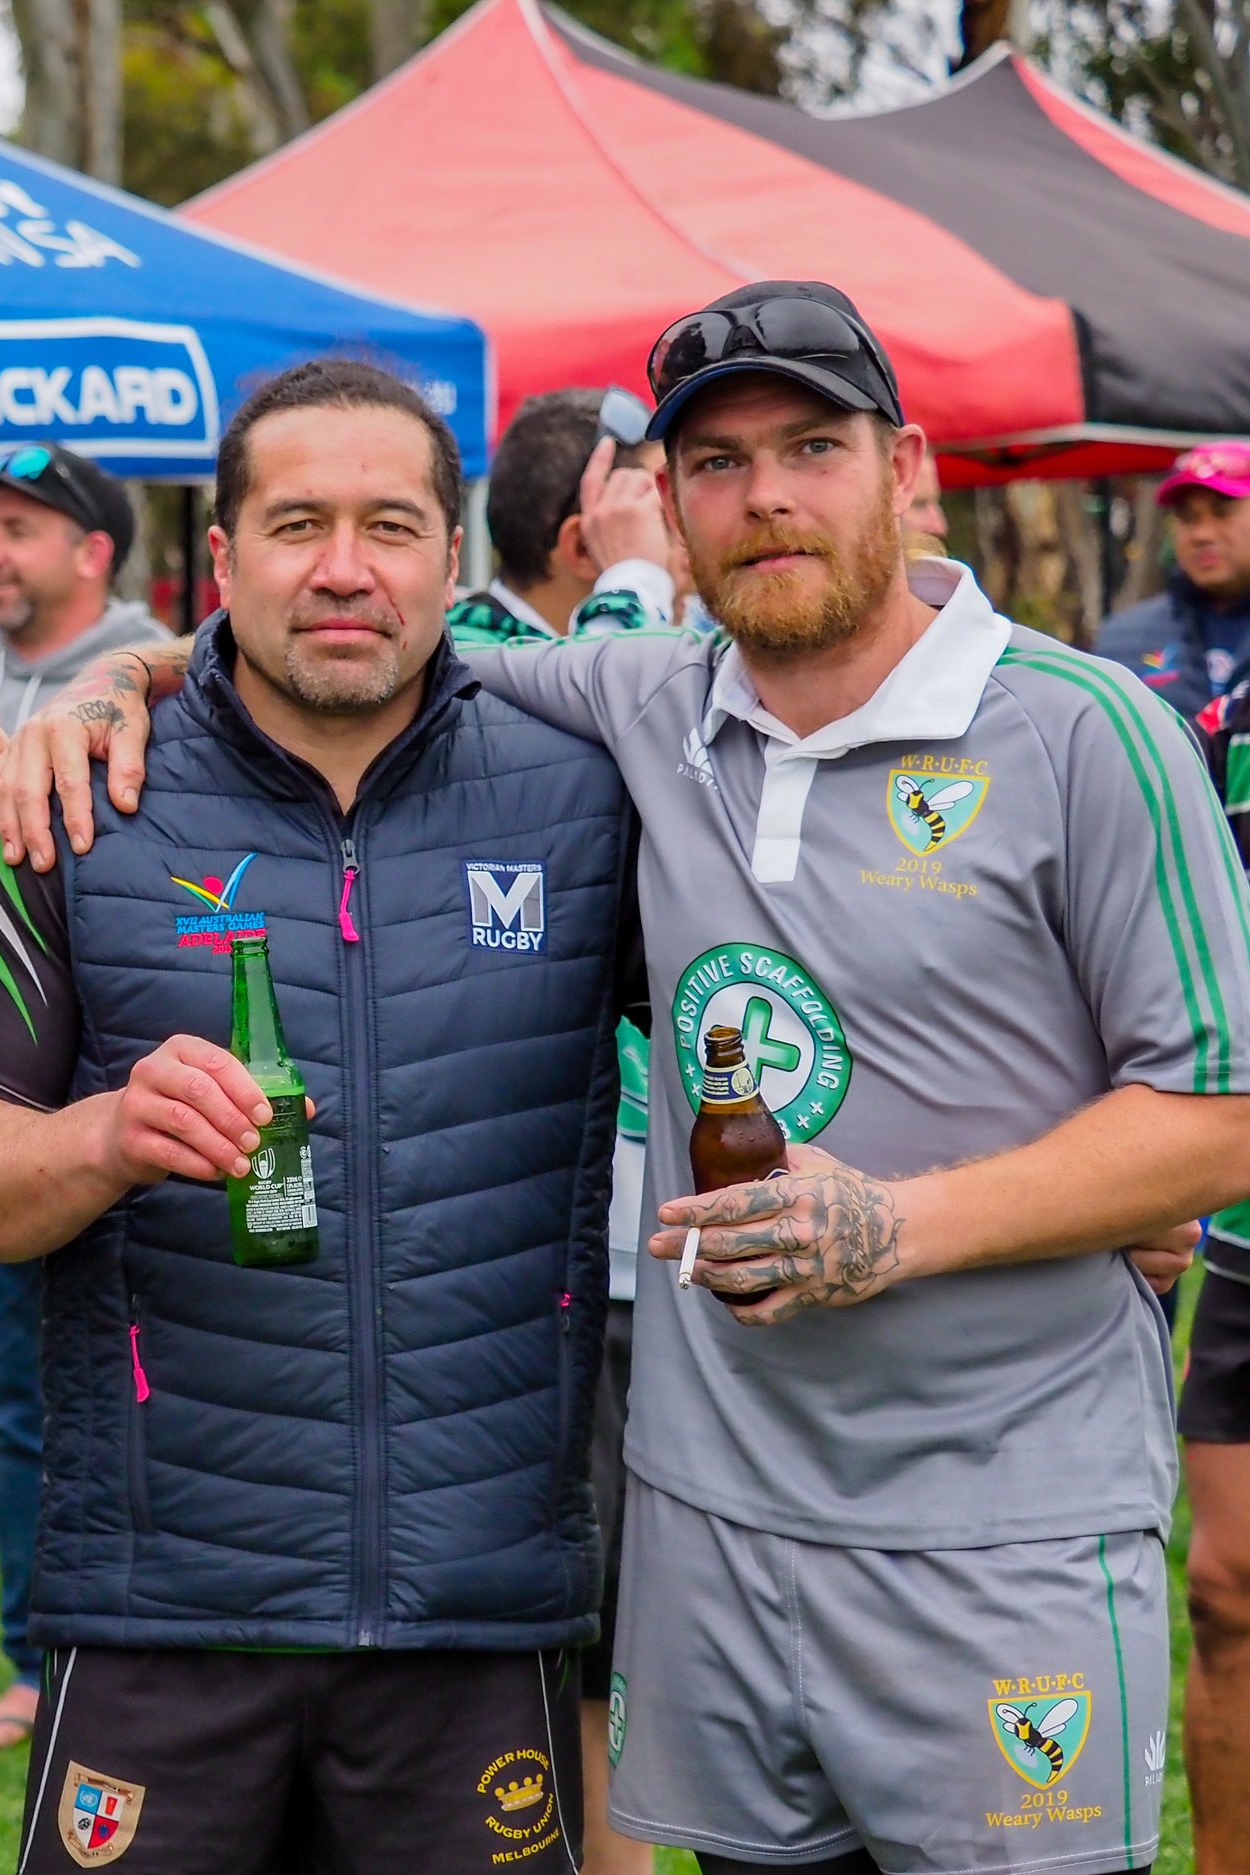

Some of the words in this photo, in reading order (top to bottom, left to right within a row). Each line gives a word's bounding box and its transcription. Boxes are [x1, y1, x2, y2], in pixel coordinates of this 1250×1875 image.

[507, 864, 543, 872] MASTERS
[895, 858, 942, 874] 2019
[861, 870, 914, 891] Weary
[919, 875, 979, 899] Wasps
[177, 923, 225, 934] MASTERS
[228, 920, 265, 930] GAMES
[198, 912, 265, 925] AUSTRALIAN
[473, 927, 543, 951] RUGBY
[677, 955, 733, 1049] POSITIVE
[740, 952, 844, 1091] SCAFFOLDING
[477, 1752, 515, 1794] POWER
[1020, 1790, 1069, 1809] 2019
[485, 1816, 531, 1839] RUGBY
[533, 1793, 554, 1833] UNION
[986, 1812, 1043, 1829] Weary
[1046, 1805, 1102, 1824] Wasps
[492, 1827, 560, 1865] MELBOURNE
